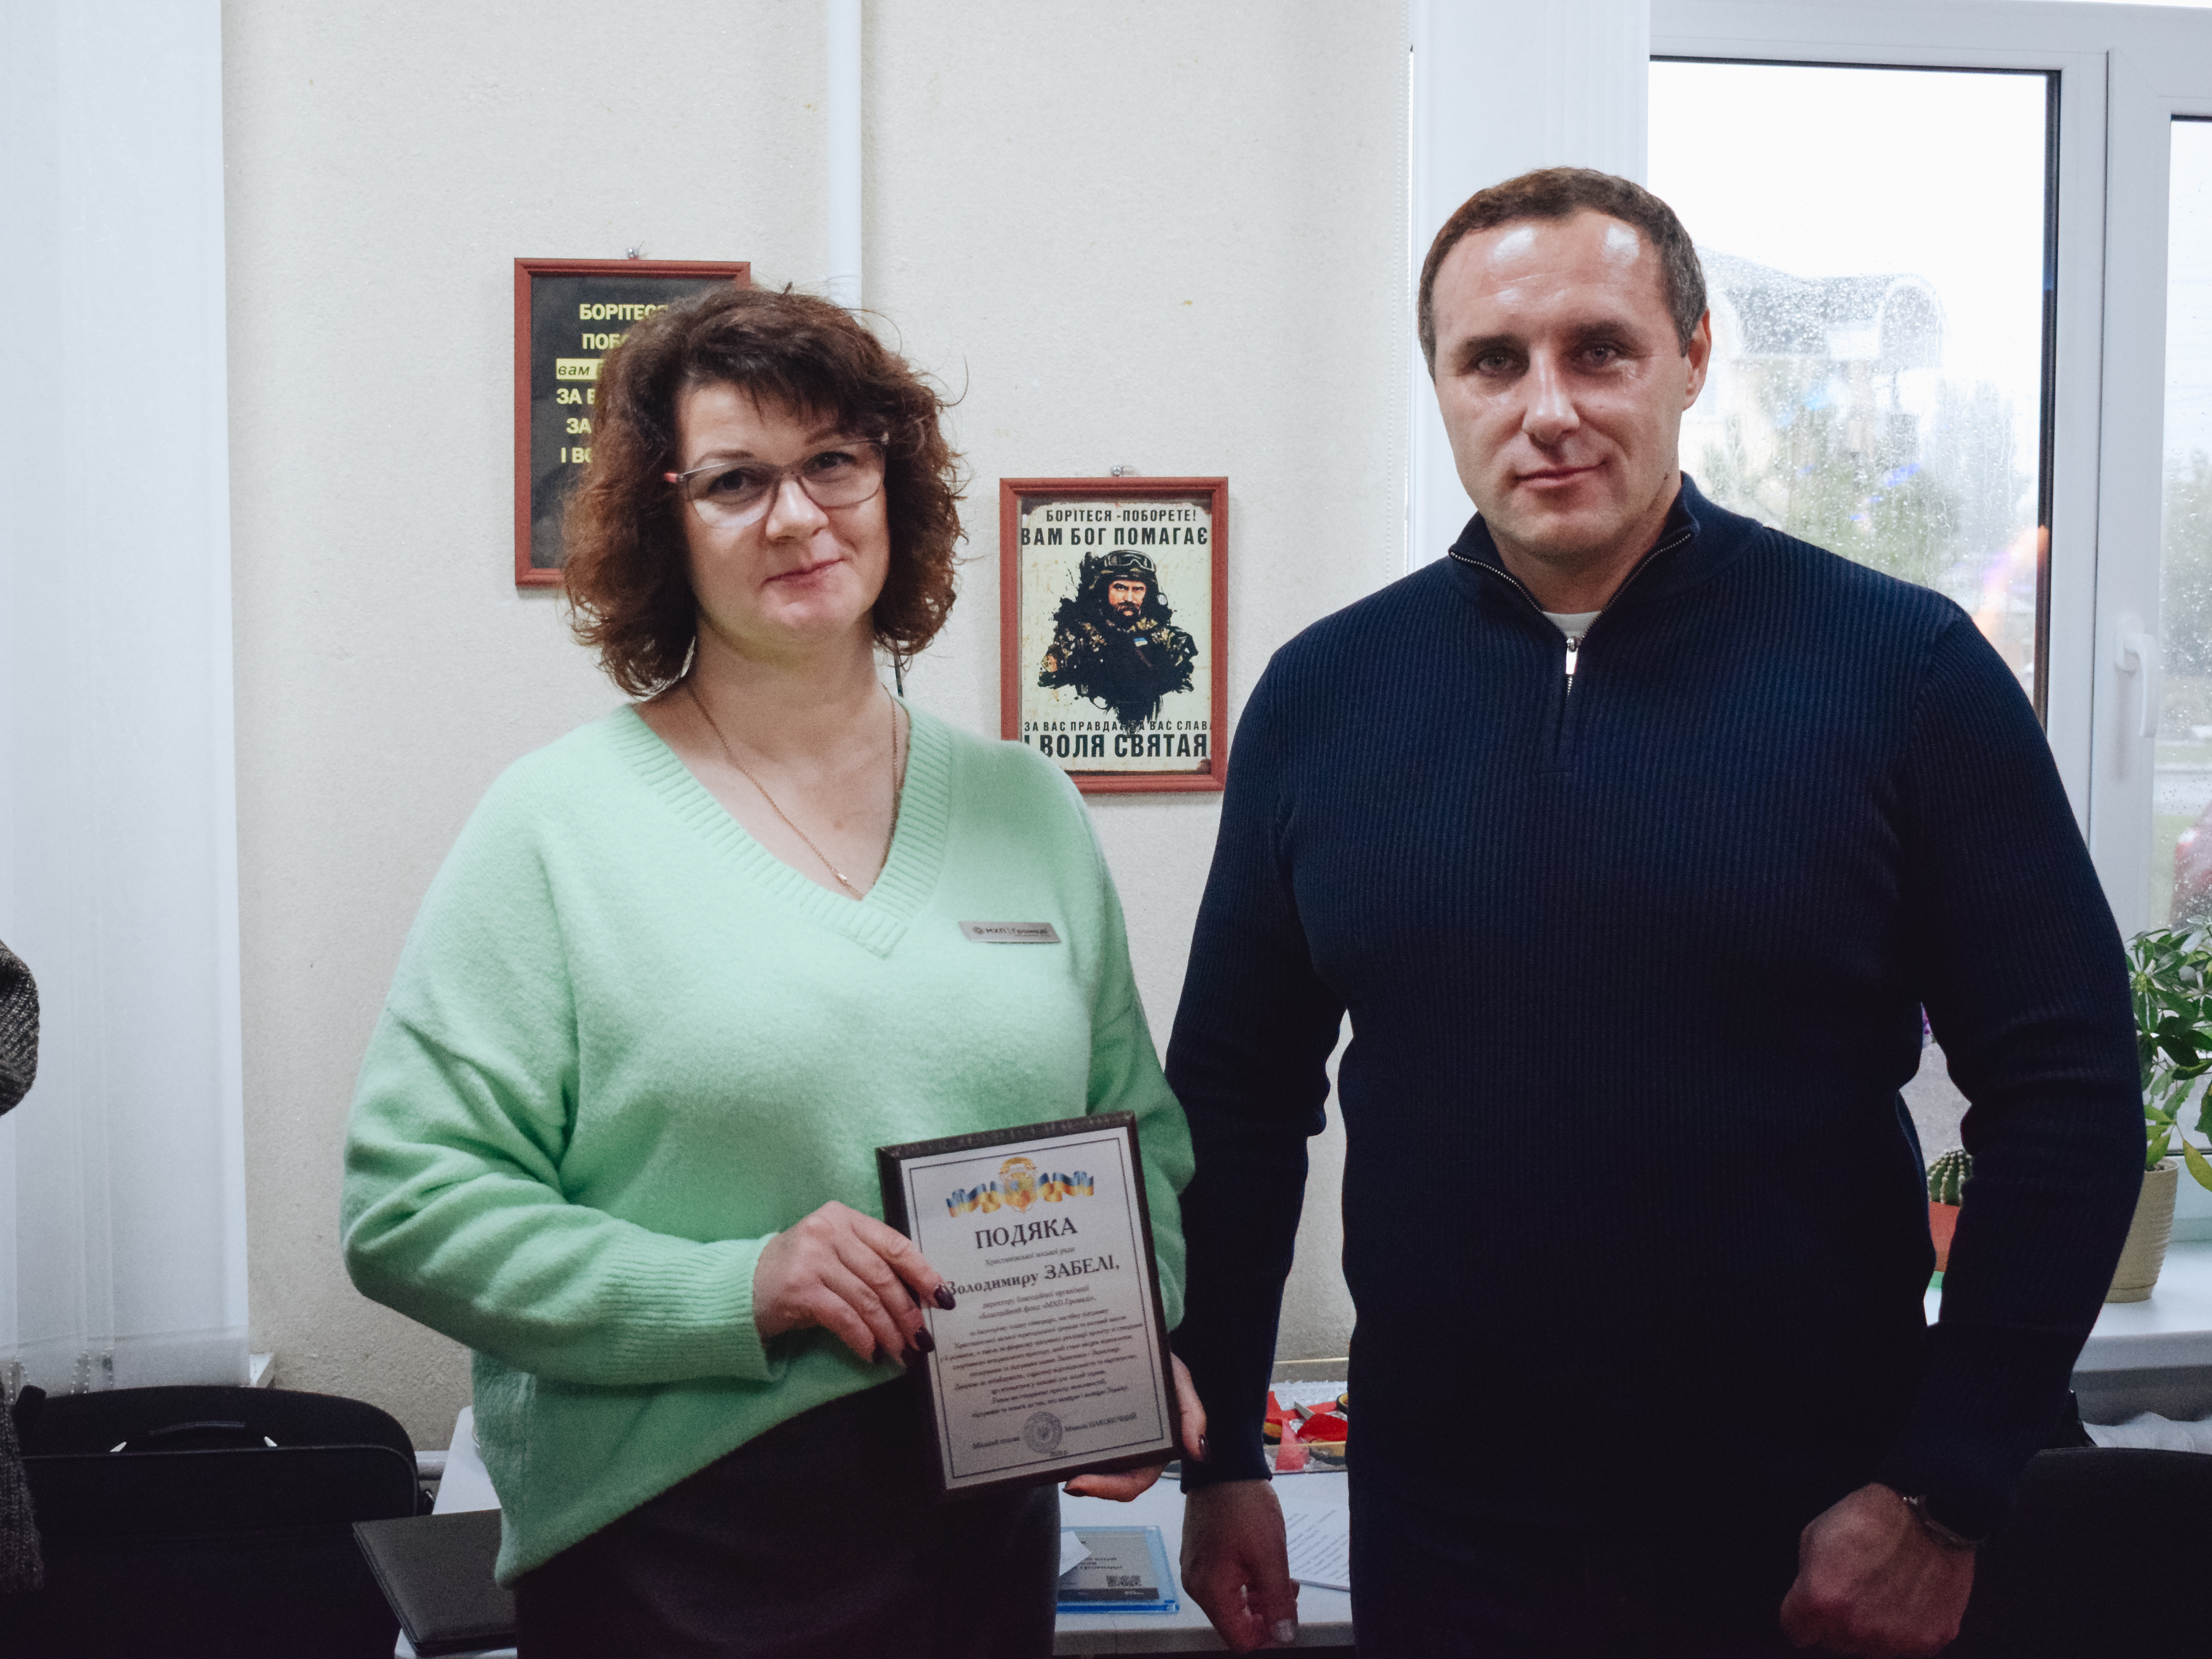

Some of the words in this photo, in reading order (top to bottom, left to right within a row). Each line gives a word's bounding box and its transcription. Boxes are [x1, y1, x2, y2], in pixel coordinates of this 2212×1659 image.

[580, 303, 669, 320] БОРІТЕС
[558, 366, 590, 376] вам
[556, 388, 583, 404] ЗА
[566, 417, 592, 434] ЗА
[1046, 510, 1111, 522] БОРІТЕСЯ
[1021, 528, 1062, 545] ВАМ
[1071, 527, 1106, 545] БОГ
[1114, 527, 1207, 545] ПОМАГАЄ
[1024, 721, 1038, 731] ЗА
[1044, 721, 1066, 731] ВАС
[1150, 721, 1172, 730] ВАС
[1177, 721, 1211, 730] СЛАВ
[1040, 734, 1104, 758] ВОЛЯ
[1114, 734, 1207, 757] СВЯТАЯ
[975, 1217, 1078, 1249] ПОДЯКА
[1044, 1255, 1120, 1280] ЗАБЕЛІ,
